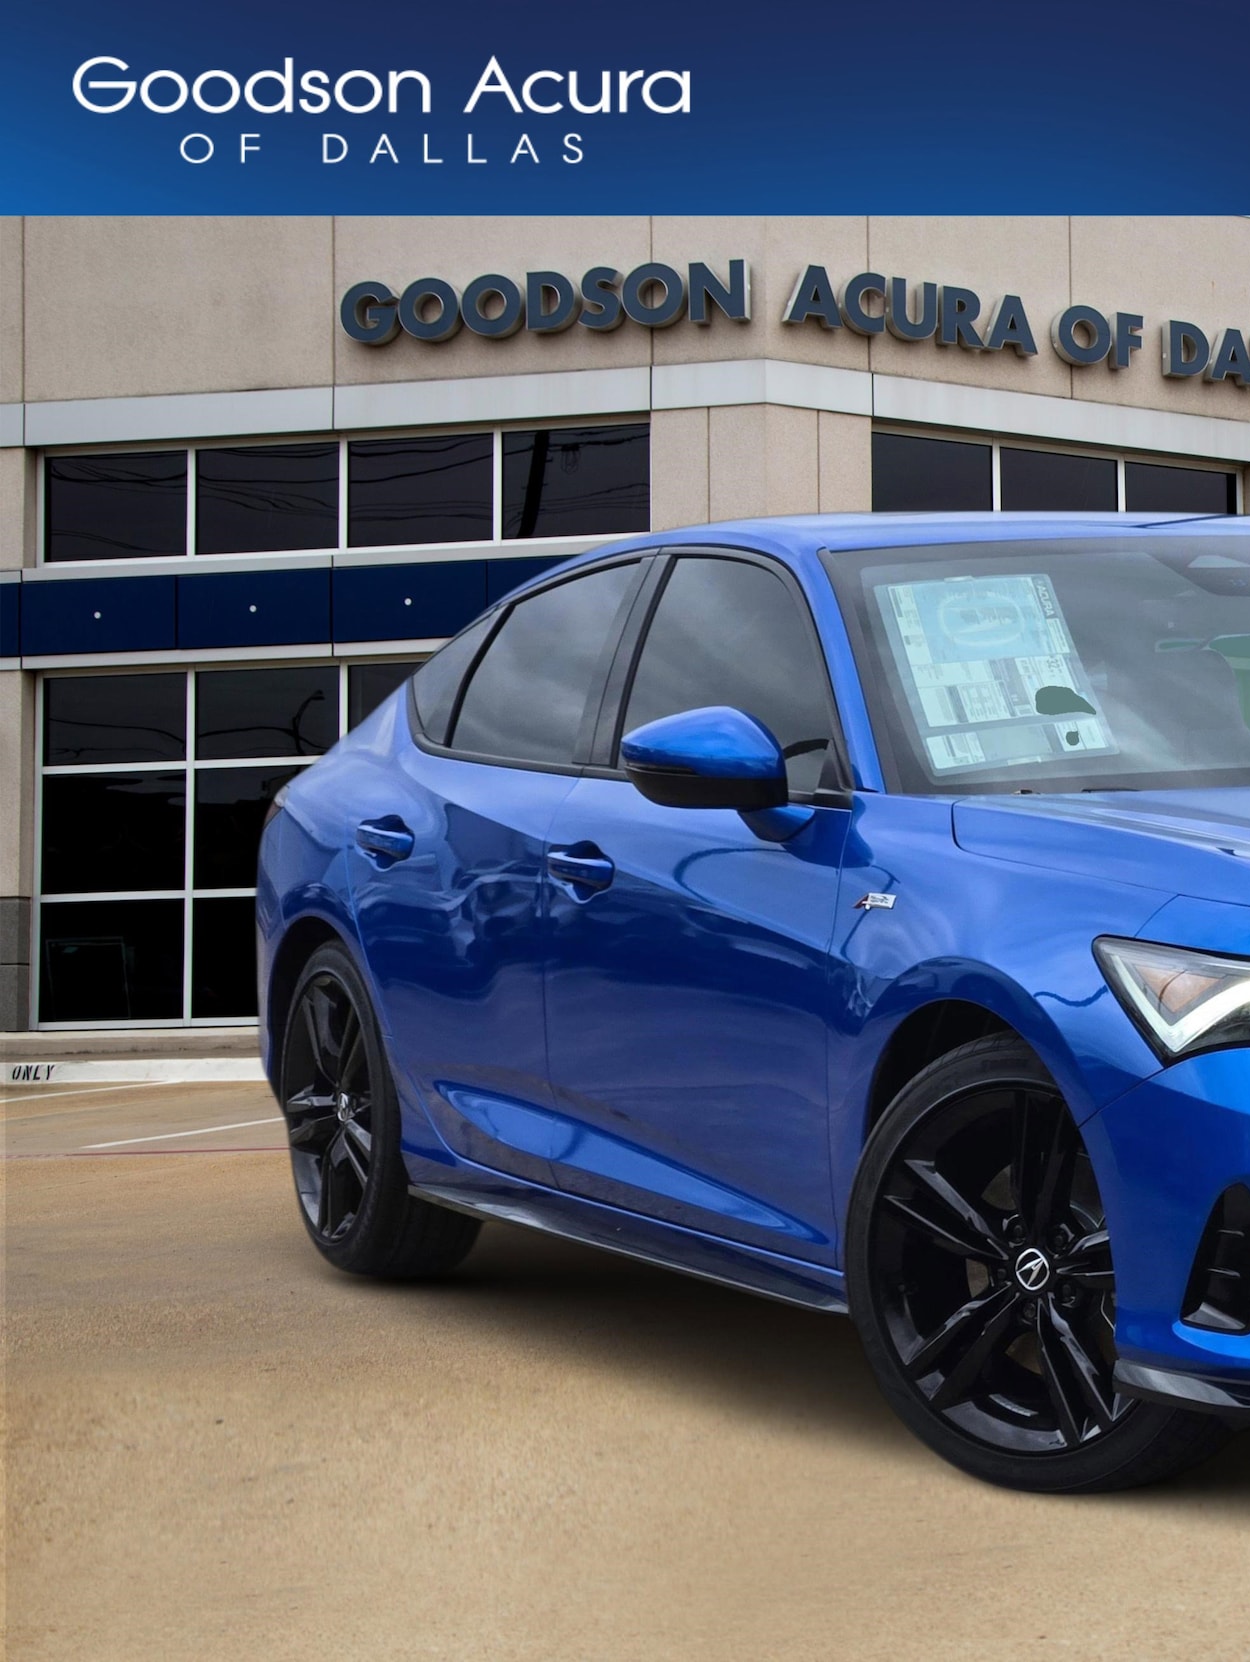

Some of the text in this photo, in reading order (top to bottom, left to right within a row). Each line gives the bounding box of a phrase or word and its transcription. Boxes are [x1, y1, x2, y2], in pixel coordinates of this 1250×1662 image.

[339, 258, 752, 348] GOODSON
[783, 264, 1038, 357] ACURA
[1051, 304, 1144, 369] OF
[1036, 584, 1056, 617] ACURA
[11, 1064, 56, 1081] ONLY
